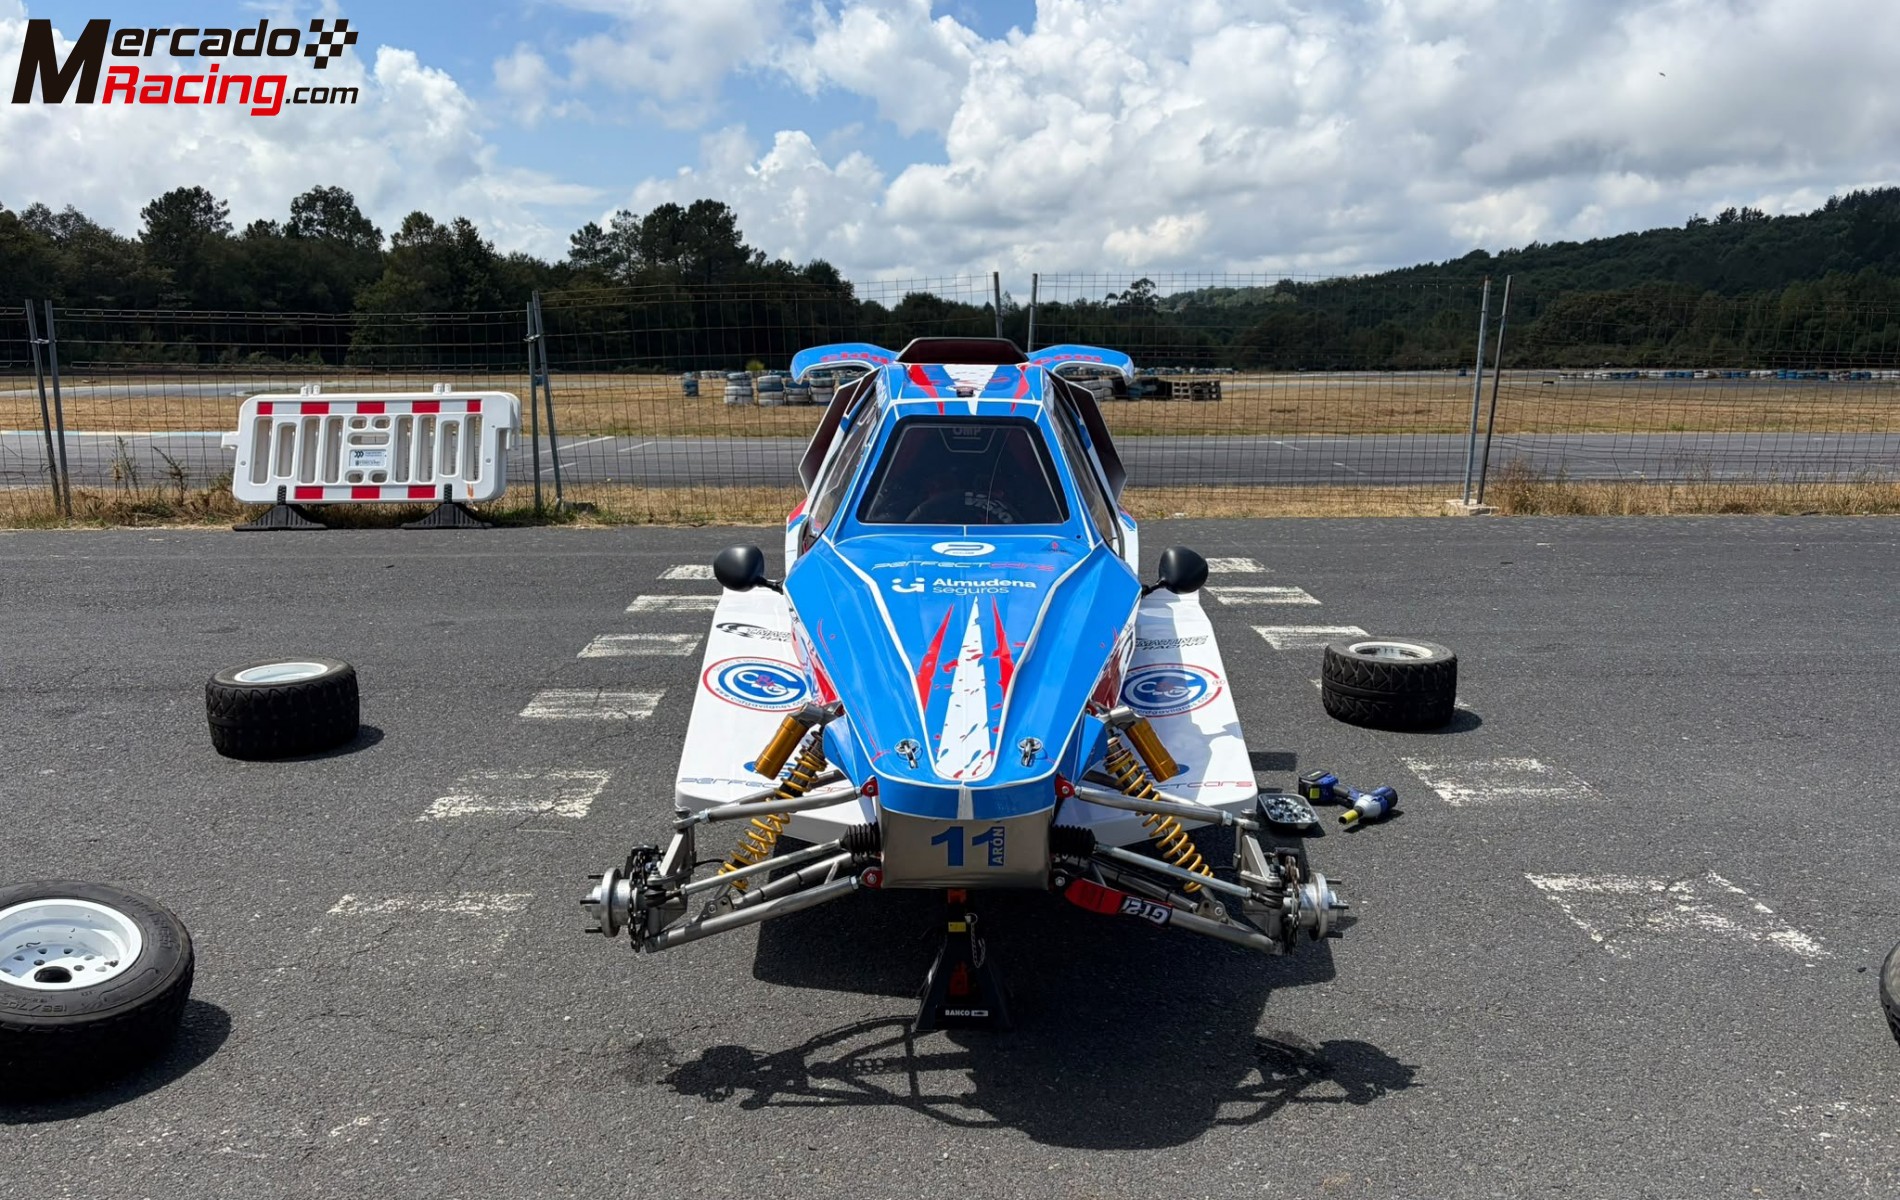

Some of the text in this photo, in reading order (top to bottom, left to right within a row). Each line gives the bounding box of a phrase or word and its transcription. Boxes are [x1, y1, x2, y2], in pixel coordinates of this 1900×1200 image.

[932, 577, 1036, 589] Almudena
[932, 586, 1010, 596] seguros
[931, 826, 1005, 867] 11
[990, 828, 1004, 865] ARÓN
